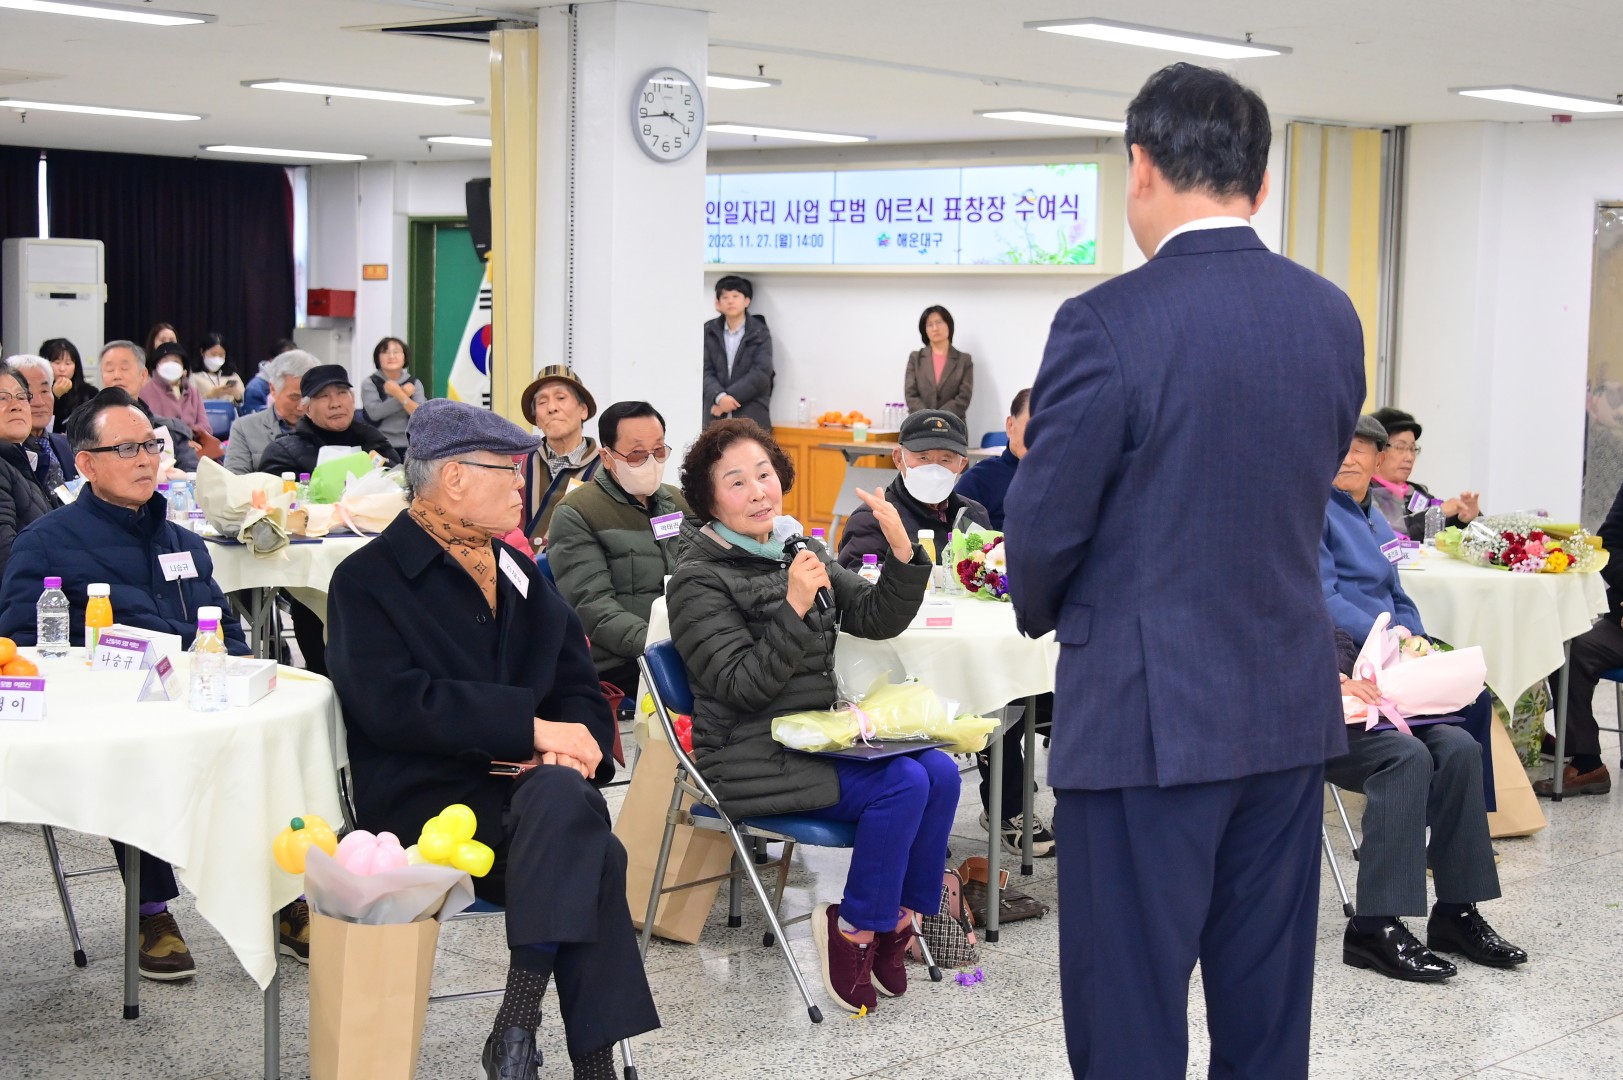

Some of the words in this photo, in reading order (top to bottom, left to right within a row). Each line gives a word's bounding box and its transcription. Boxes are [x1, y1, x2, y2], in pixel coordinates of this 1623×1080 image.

[663, 77, 674, 89] 12
[643, 92, 655, 103] 10
[684, 94, 692, 106] 2
[640, 107, 648, 118] 9
[688, 111, 695, 122] 3
[642, 124, 652, 136] 8
[682, 126, 690, 138] 4
[652, 135, 660, 147] 7
[661, 141, 671, 153] 6
[674, 137, 682, 149] 5
[705, 200, 776, 225] 인일자리
[784, 199, 819, 224] 사업
[828, 198, 866, 224] 모범
[876, 197, 933, 223] 어르신
[943, 196, 1005, 223] 표창장
[1015, 194, 1079, 222] 수여식
[708, 234, 735, 248] 2023.
[739, 234, 753, 248] 11.
[796, 234, 824, 248] 14:00
[896, 232, 943, 248] 해운대구
[102, 652, 133, 670] 나승규
